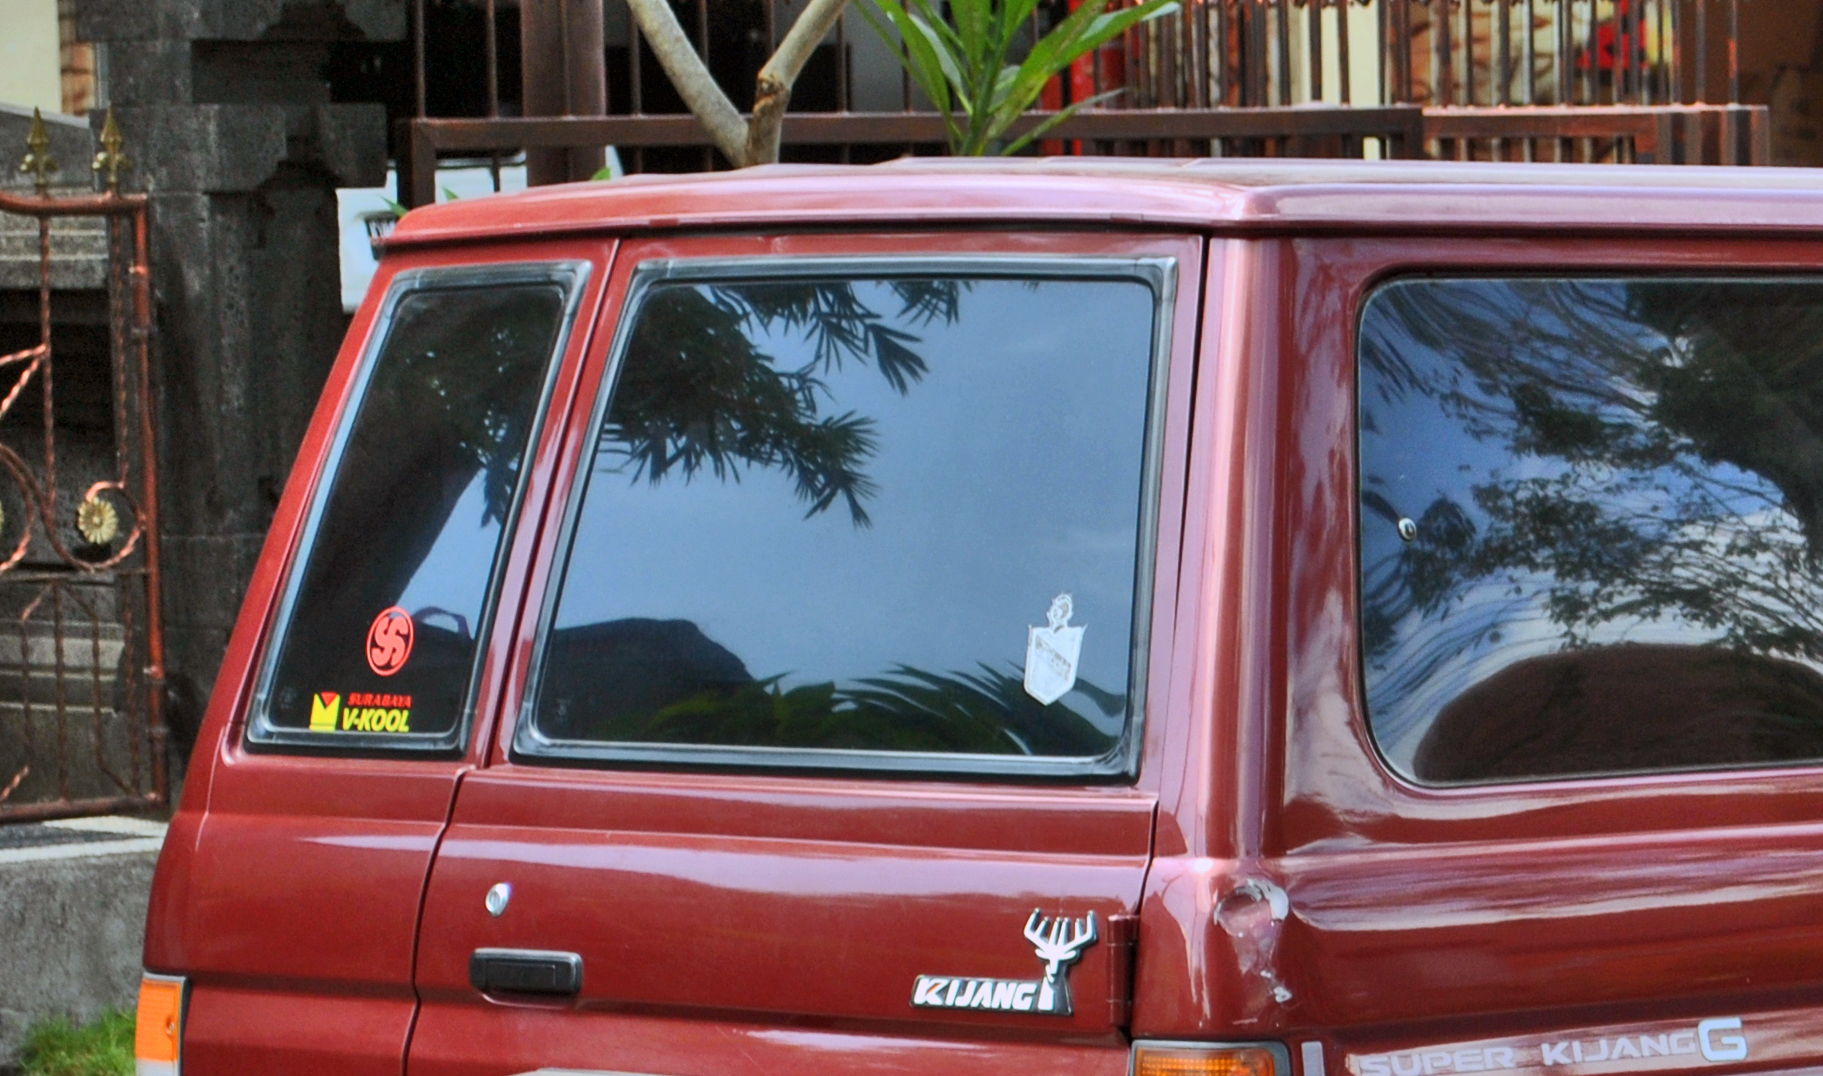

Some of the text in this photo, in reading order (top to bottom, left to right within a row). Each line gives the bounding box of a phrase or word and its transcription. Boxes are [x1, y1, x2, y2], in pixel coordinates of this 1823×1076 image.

[343, 707, 409, 733] V-KOOL
[913, 977, 1037, 1011] KIJANG
[1541, 1029, 1697, 1065] KIJANG
[1698, 1017, 1747, 1062] G
